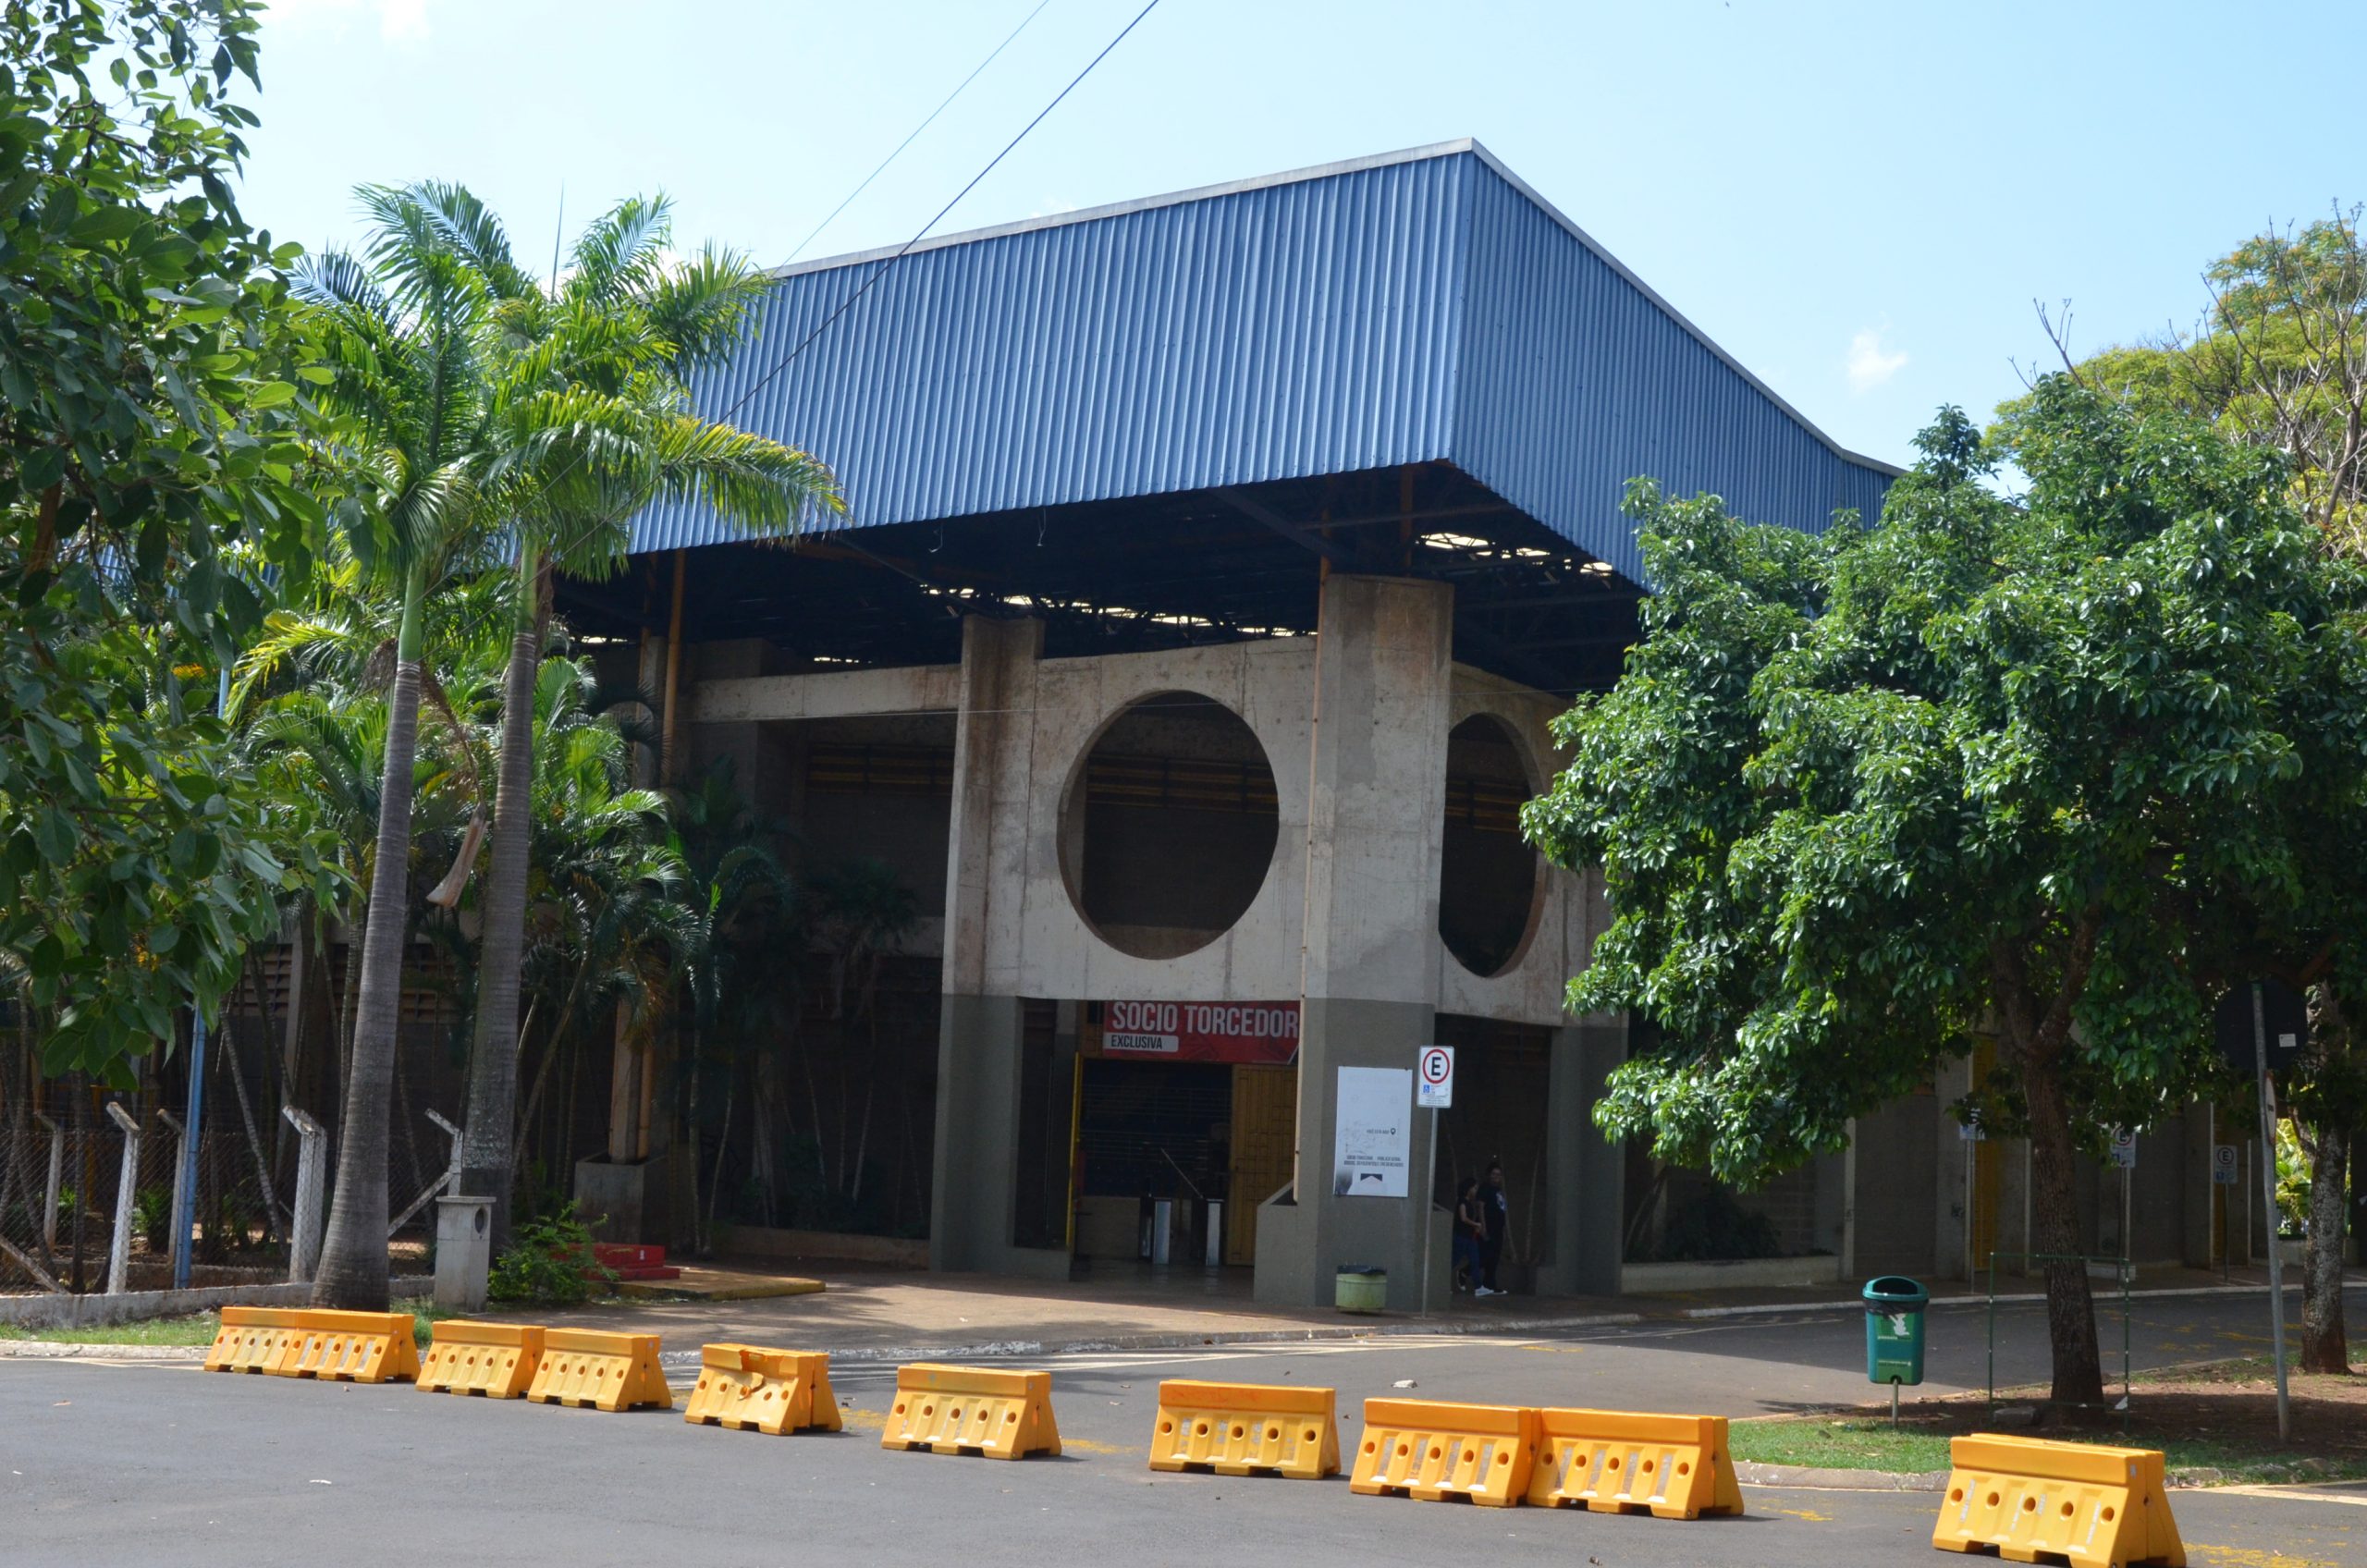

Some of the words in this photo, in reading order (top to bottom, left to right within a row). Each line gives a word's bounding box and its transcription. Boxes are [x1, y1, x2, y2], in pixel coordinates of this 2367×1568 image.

[1184, 1005, 1298, 1038] TORCEDOR
[1111, 1035, 1162, 1049] EXCLUSIVA
[1431, 1057, 1441, 1076] E
[2223, 1151, 2229, 1161] E
